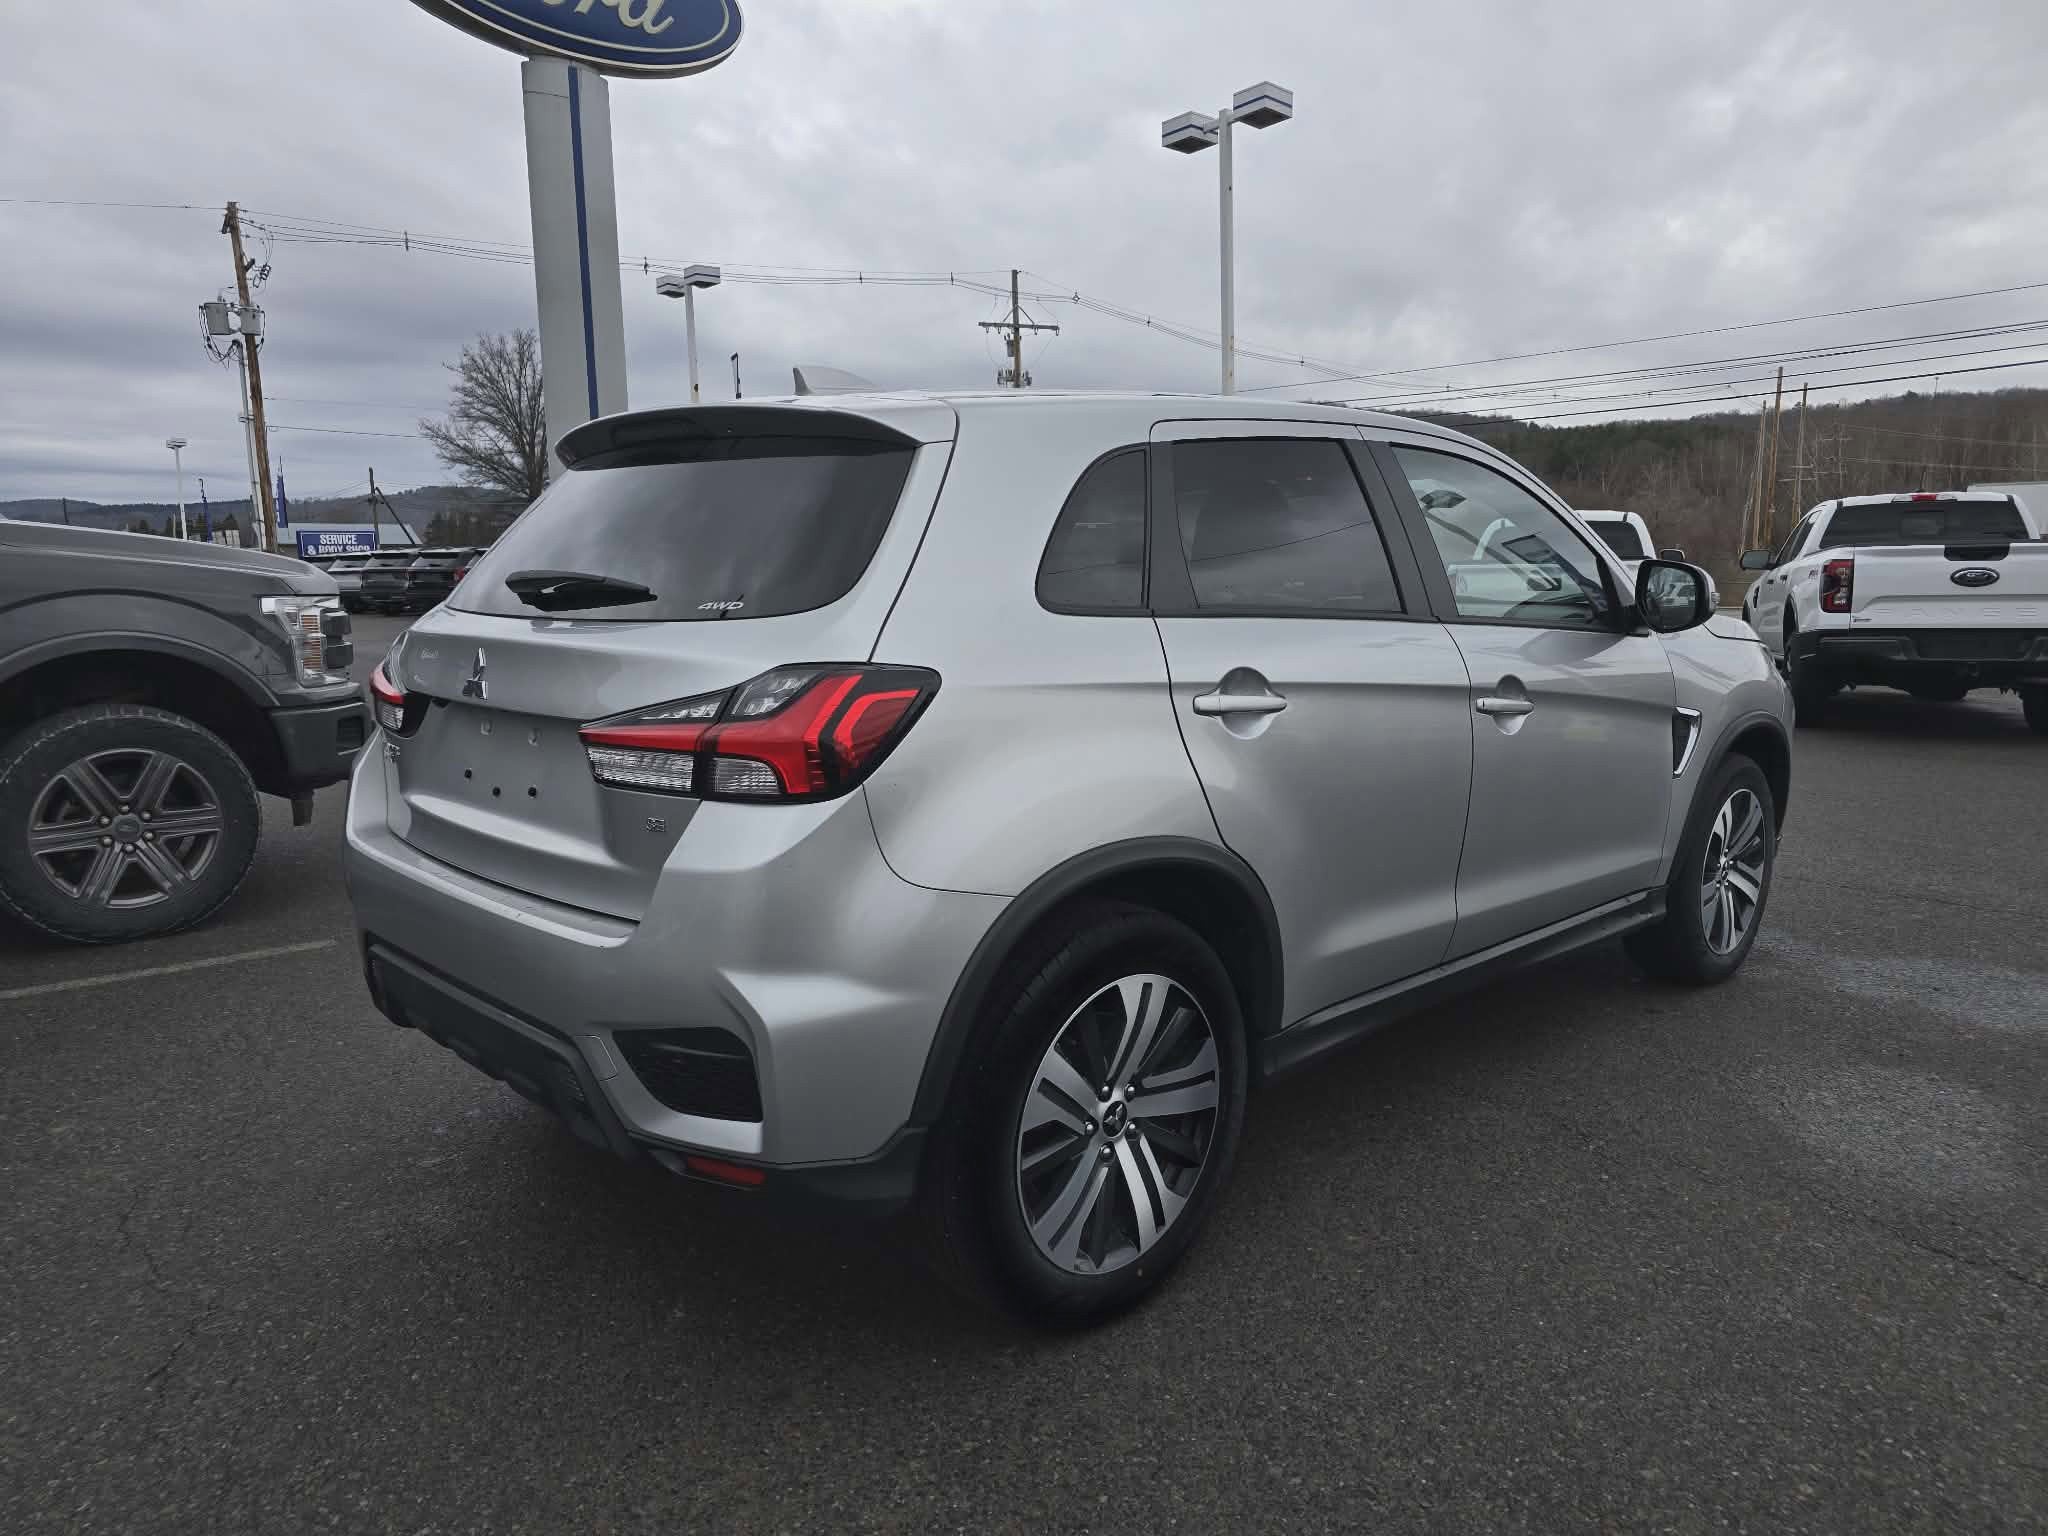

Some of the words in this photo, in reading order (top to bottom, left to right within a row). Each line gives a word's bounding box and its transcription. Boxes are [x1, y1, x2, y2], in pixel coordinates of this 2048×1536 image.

[319, 534, 358, 545] SERVICE
[307, 545, 316, 555] &
[318, 545, 343, 553] BODY
[697, 600, 745, 610] 4WD
